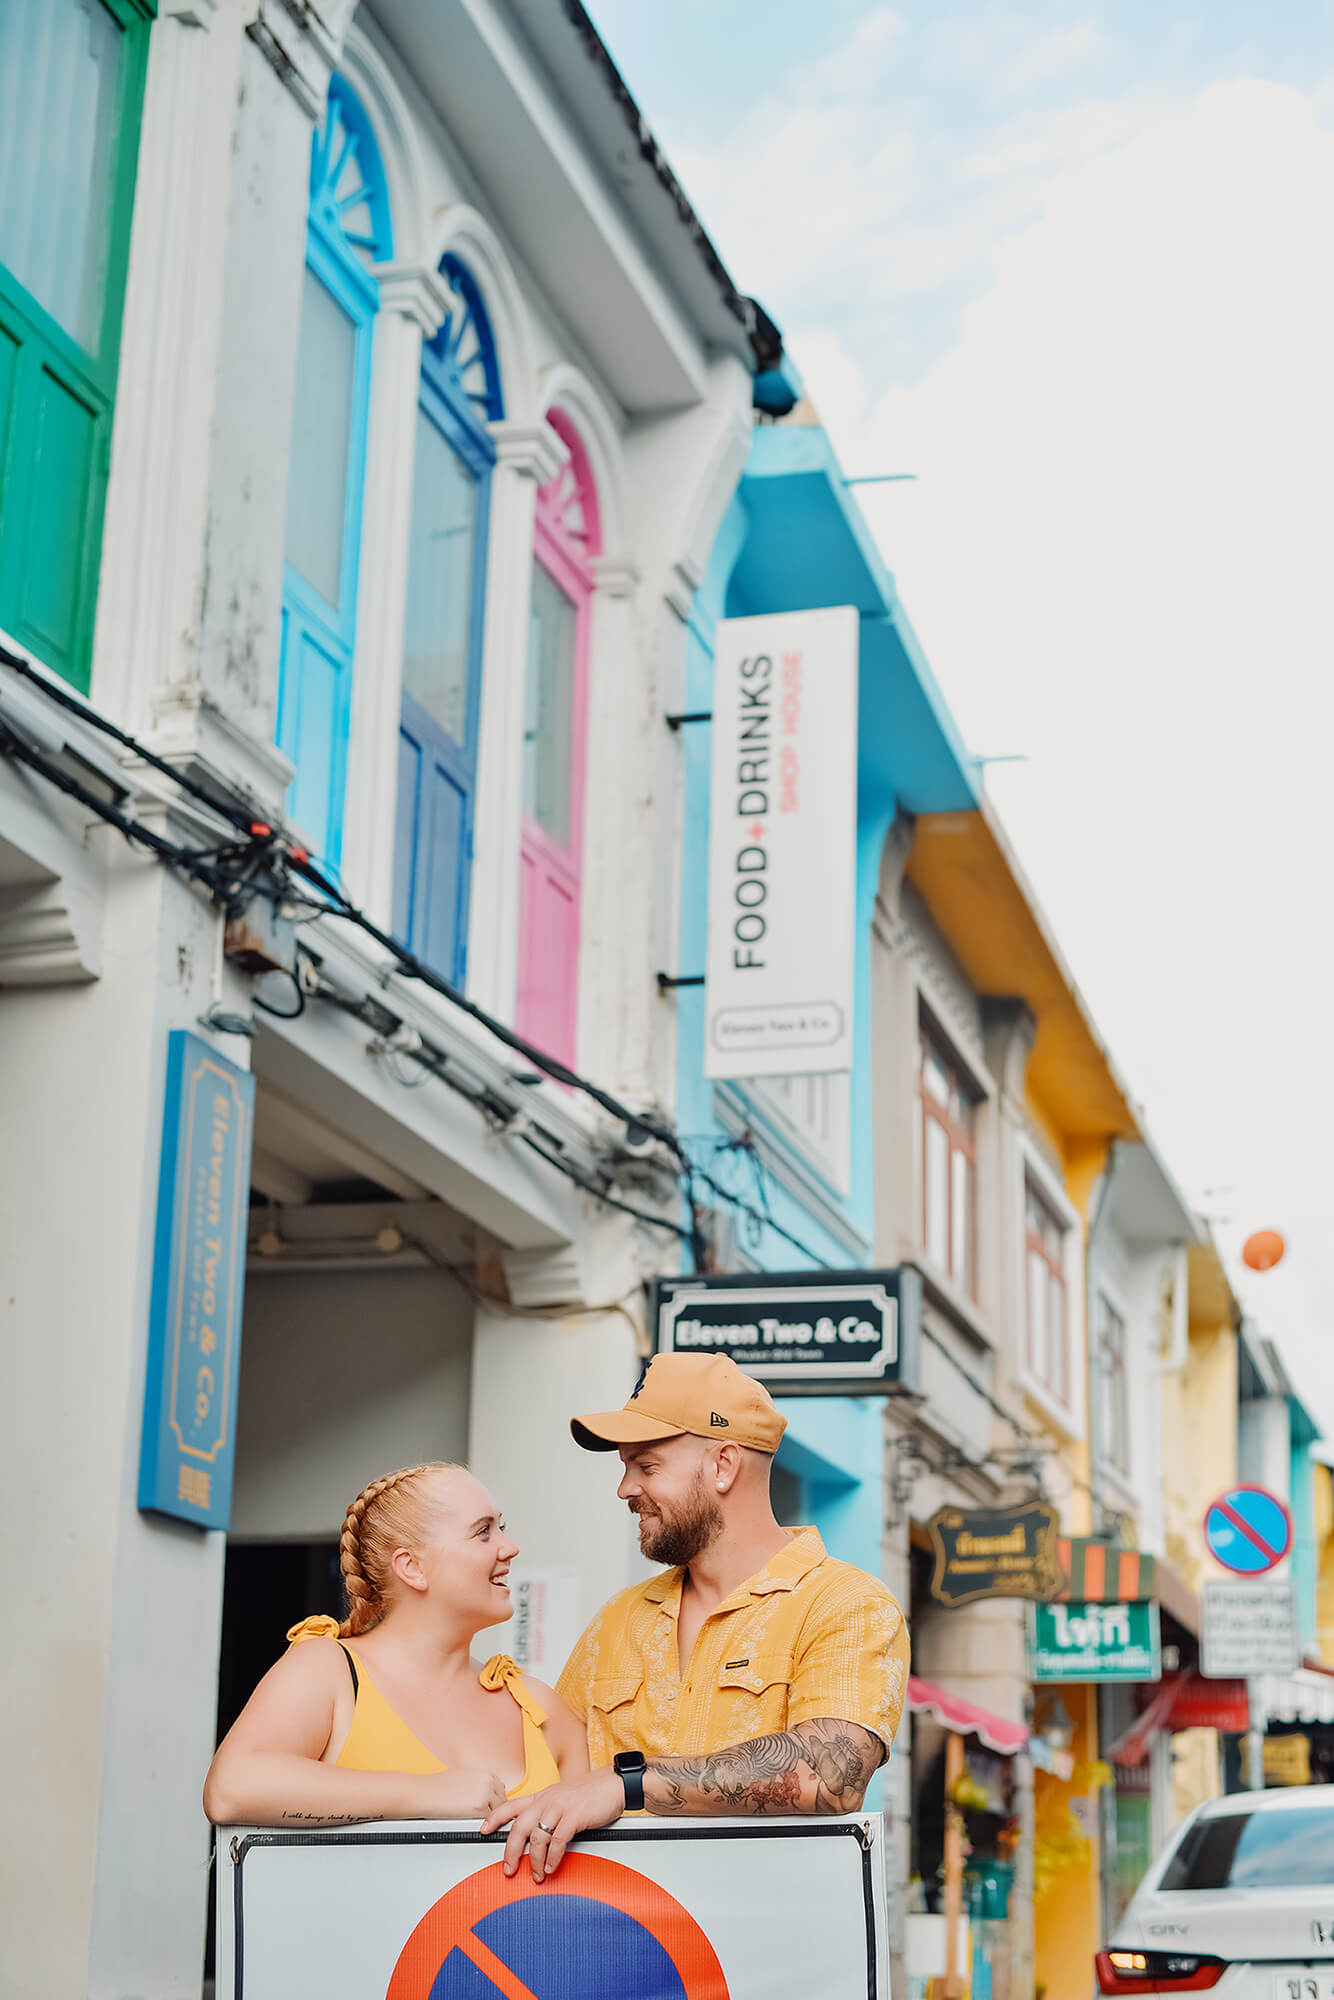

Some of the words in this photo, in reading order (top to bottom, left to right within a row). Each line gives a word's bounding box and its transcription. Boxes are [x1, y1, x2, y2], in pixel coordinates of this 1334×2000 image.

[782, 651, 802, 735] HOUSE
[780, 745, 799, 814] SHOP
[207, 1094, 230, 1225] Eleven
[203, 1236, 221, 1316] Two
[200, 1324, 216, 1355] &
[676, 1319, 759, 1346] Eleven
[759, 1318, 813, 1345] Two
[814, 1316, 837, 1344] &
[838, 1315, 881, 1343] Co.
[195, 1365, 214, 1427] Co.
[1150, 1924, 1190, 1936] CITY
